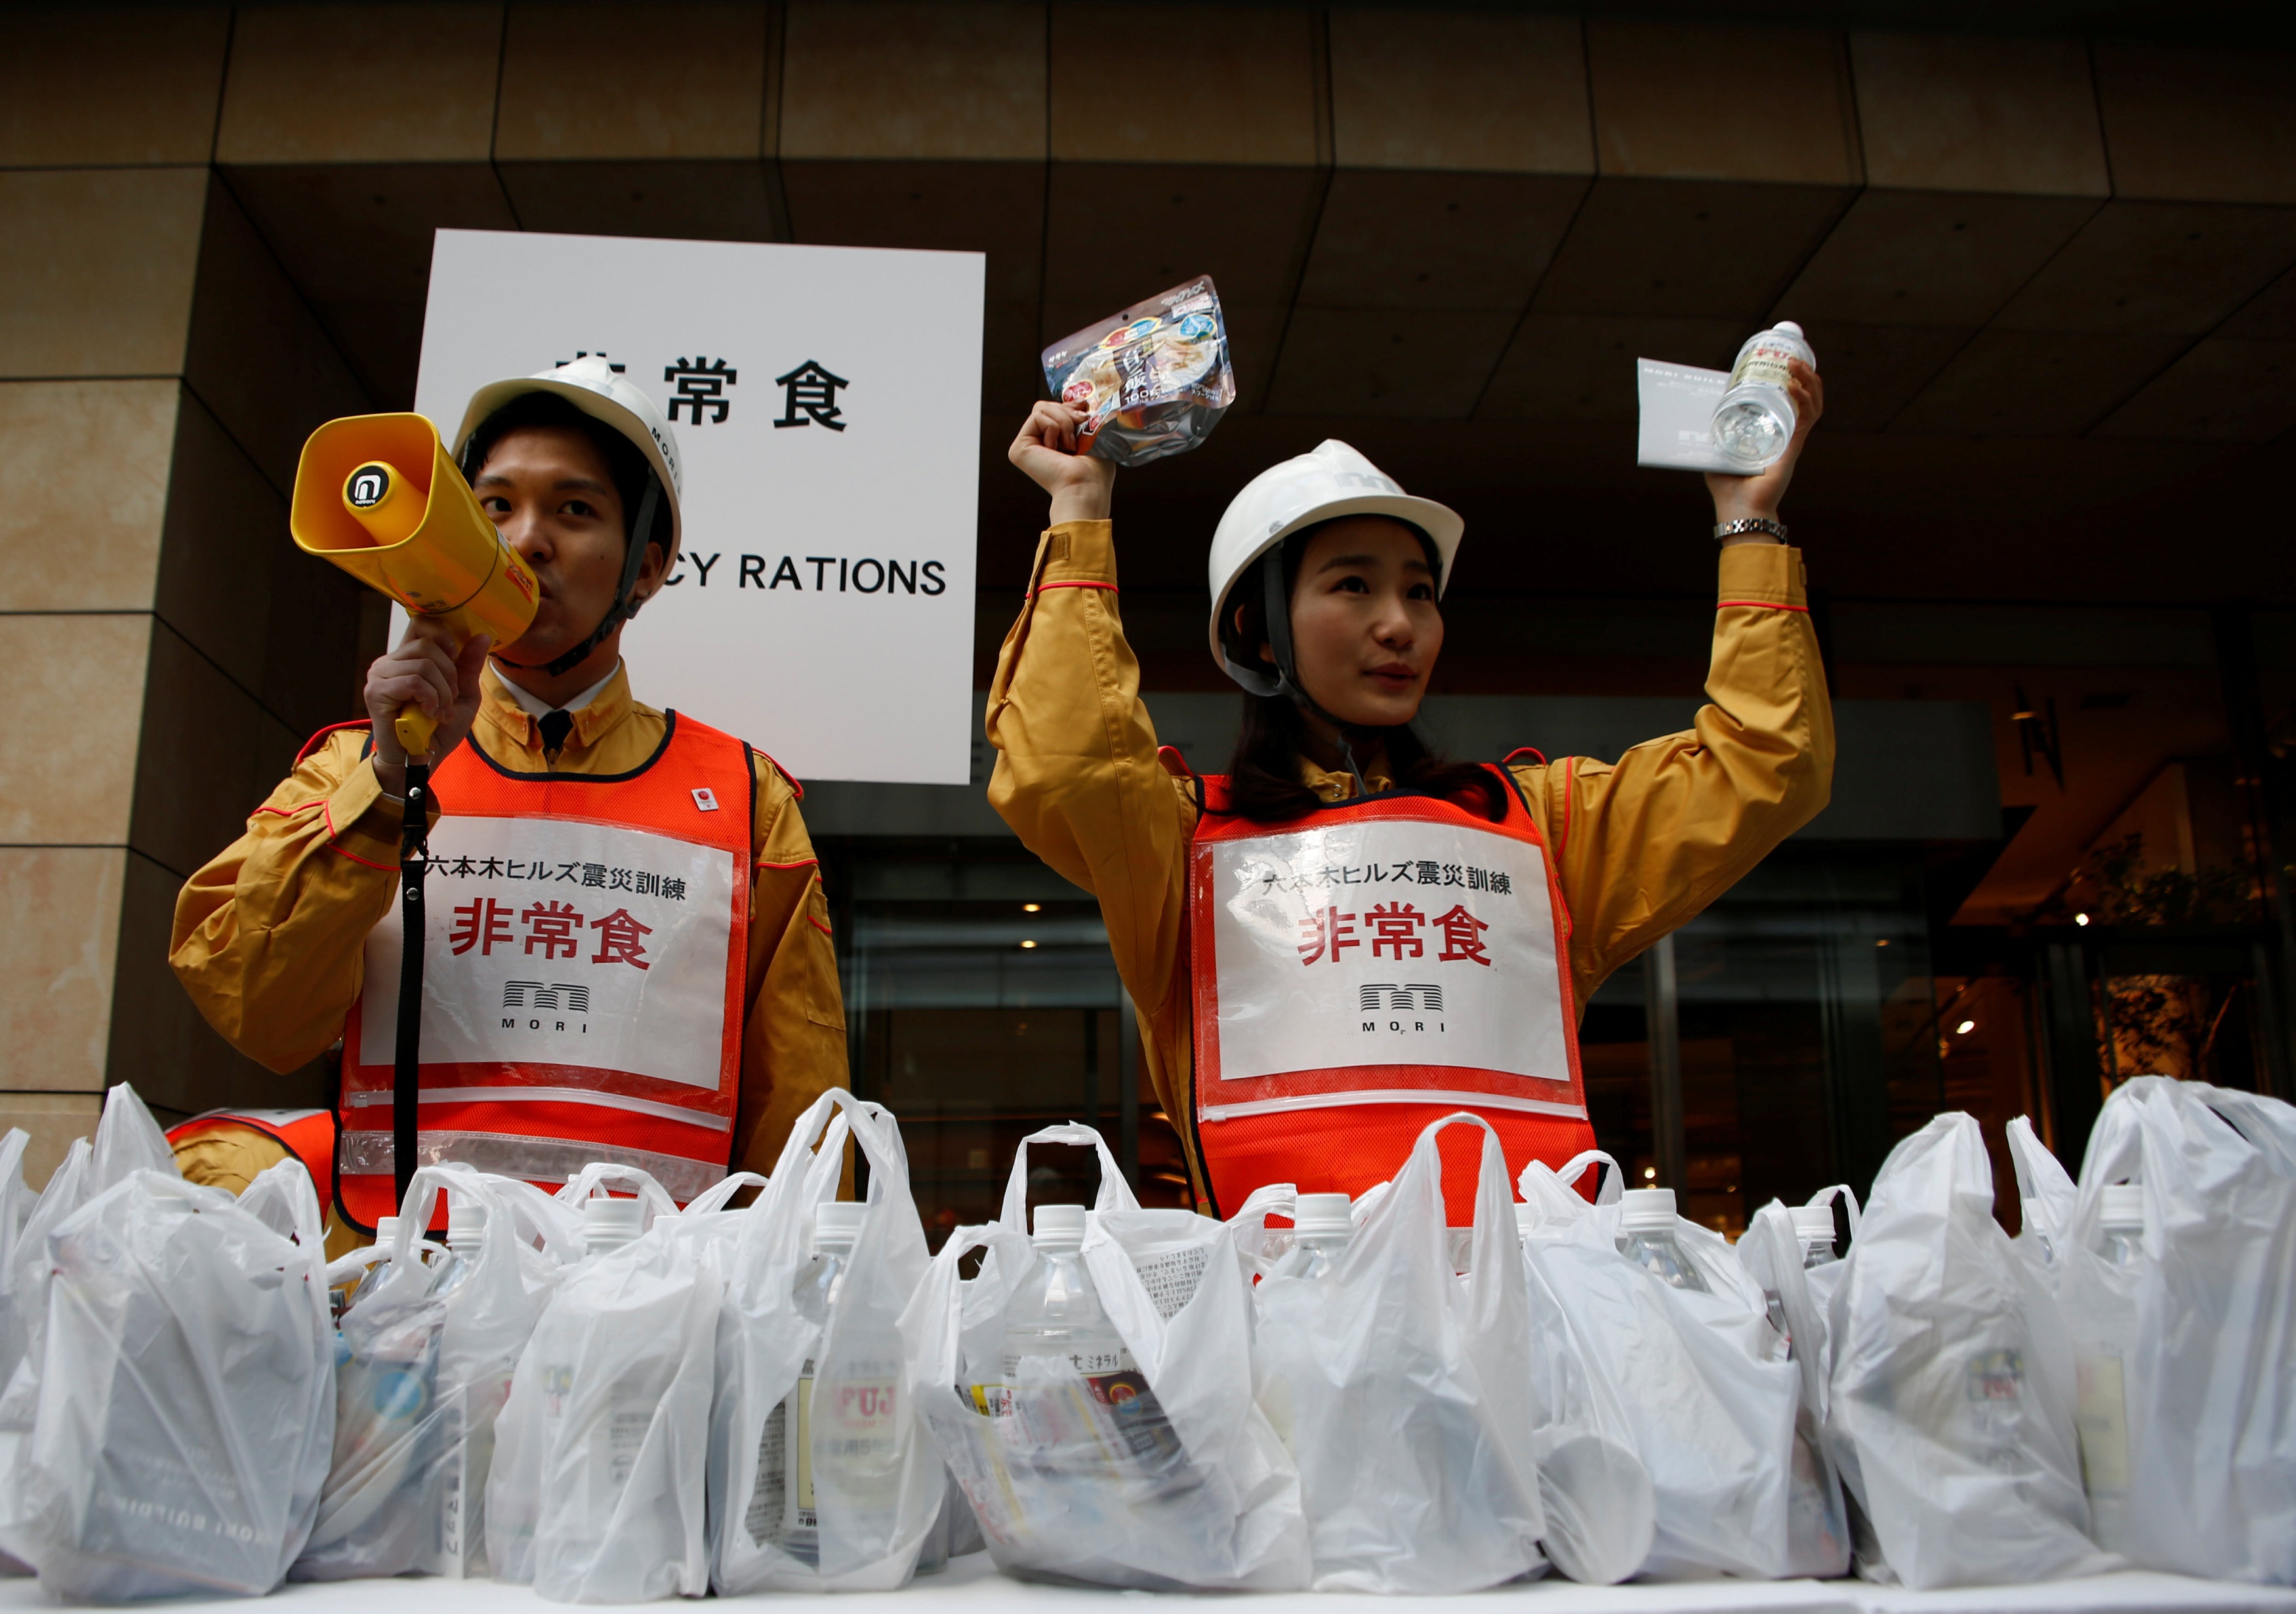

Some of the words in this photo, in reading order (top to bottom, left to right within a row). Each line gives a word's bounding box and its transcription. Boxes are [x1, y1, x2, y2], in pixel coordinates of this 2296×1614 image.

[556, 352, 850, 432] 常食
[739, 555, 947, 596] RATIONS
[424, 855, 686, 902] 六本木ヒルズ震災訓練
[449, 897, 653, 971] 非常食
[1298, 902, 1491, 967] 非常食
[502, 1018, 588, 1034] MORI
[1362, 1020, 1445, 1033] MORI
